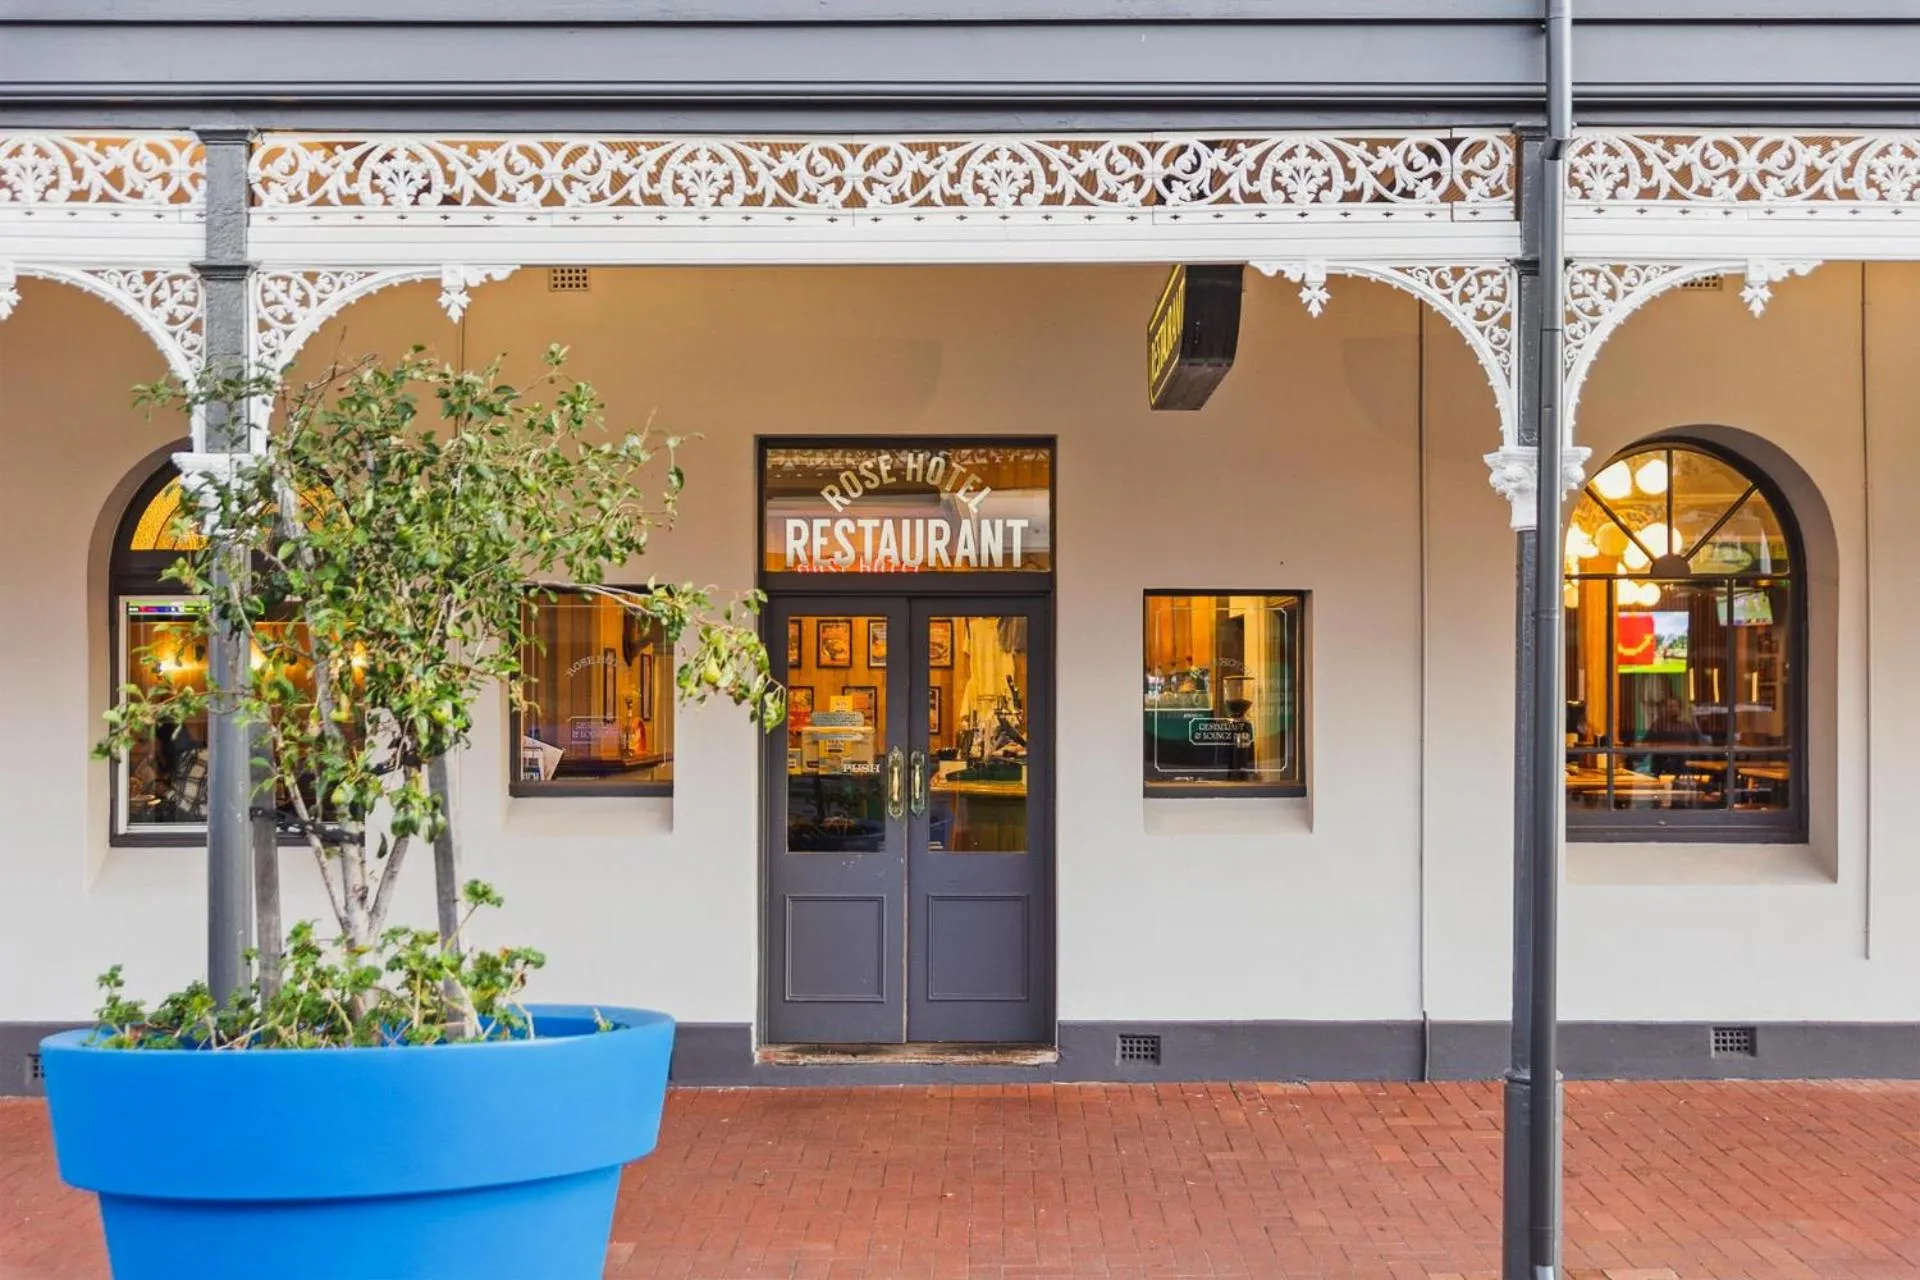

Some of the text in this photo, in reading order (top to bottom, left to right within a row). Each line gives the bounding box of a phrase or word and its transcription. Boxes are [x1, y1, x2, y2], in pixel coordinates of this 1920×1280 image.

[820, 452, 992, 513] ROSE HOTEL
[785, 518, 1029, 568] RESTAURANT
[842, 763, 881, 773] PUSH
